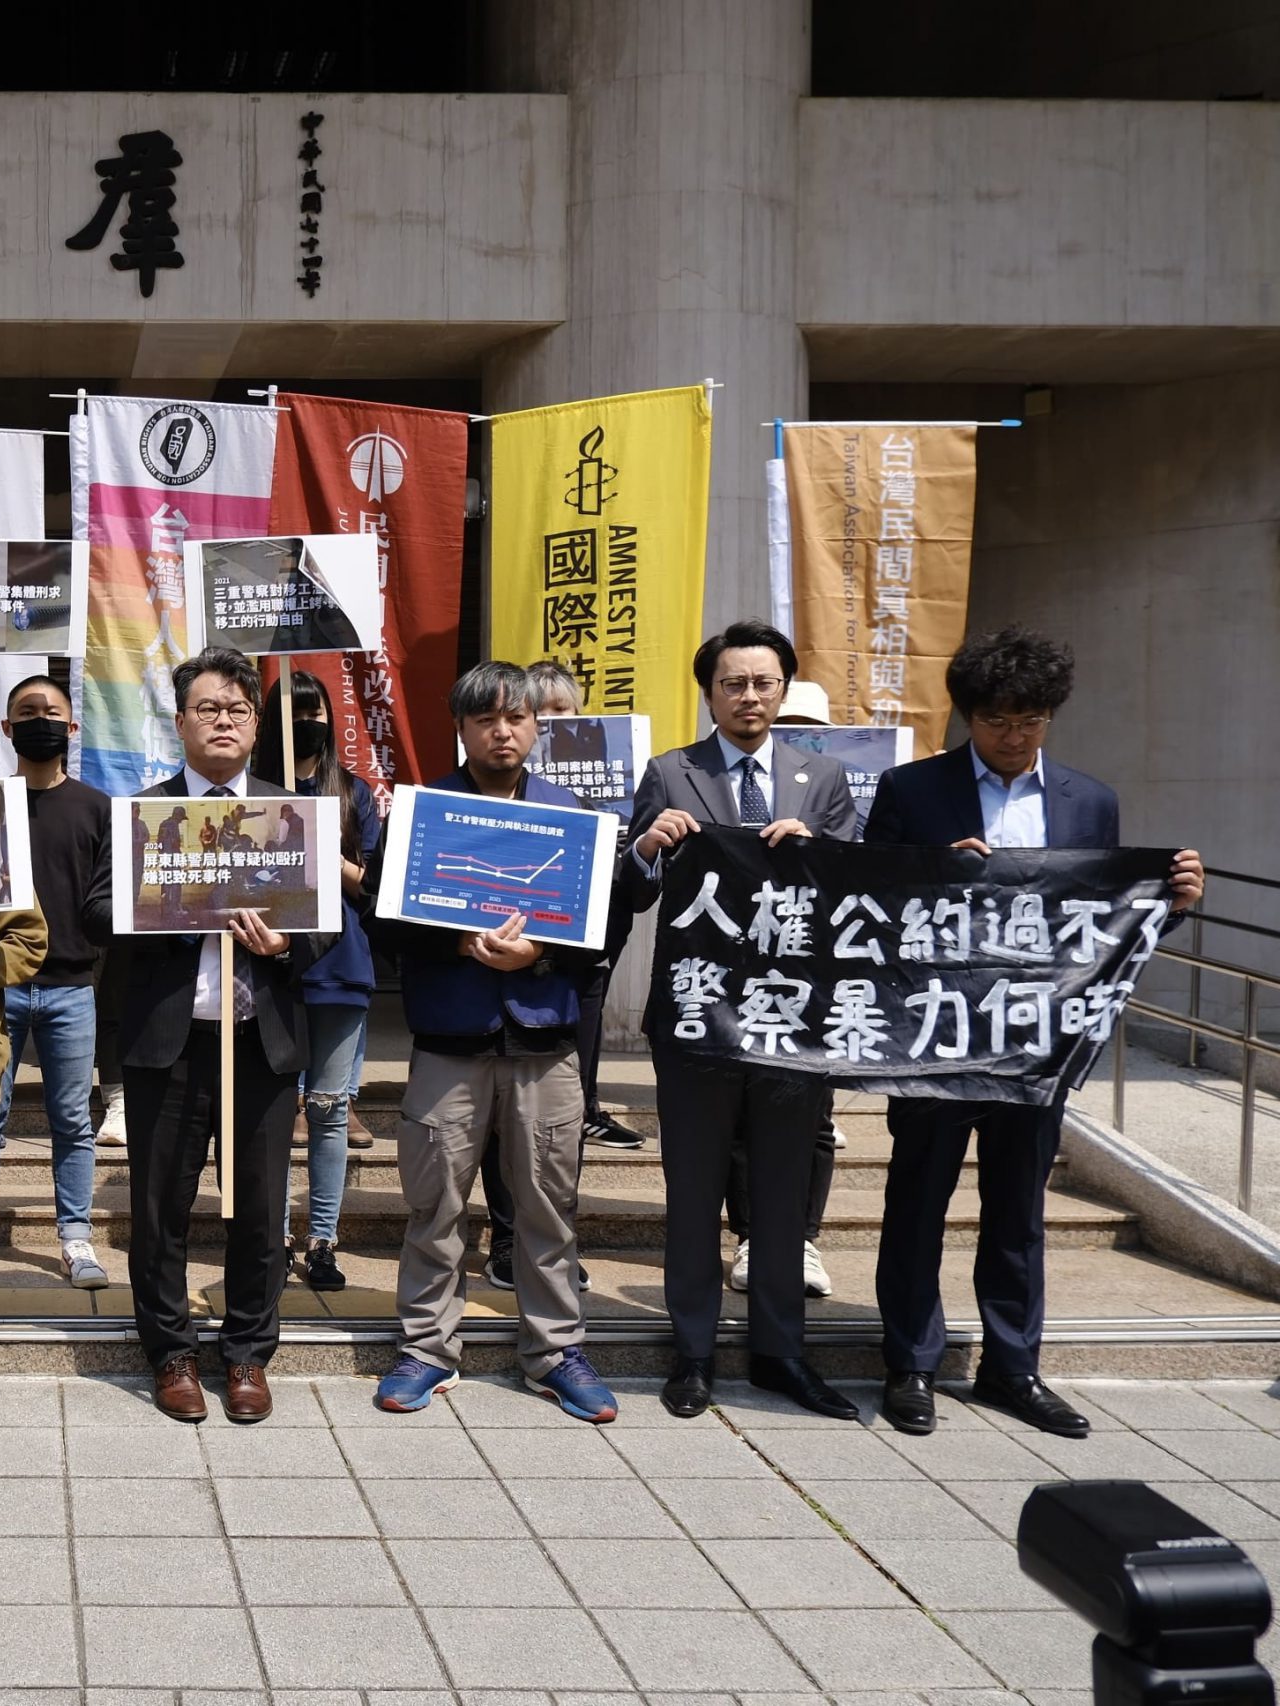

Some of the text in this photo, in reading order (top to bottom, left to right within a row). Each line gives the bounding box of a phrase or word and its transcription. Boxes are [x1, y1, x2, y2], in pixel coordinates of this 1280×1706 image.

[842, 433, 860, 498] Taiwan
[843, 507, 861, 613] Association
[606, 525, 637, 655] AMNESTY
[215, 612, 304, 630] 移工的行動自由
[143, 851, 306, 868] 屏東縣警局員警疑似毆打
[144, 842, 163, 850] 2024
[143, 869, 232, 885] 嫌犯致死事件
[670, 870, 1171, 966] 人權公約過不了
